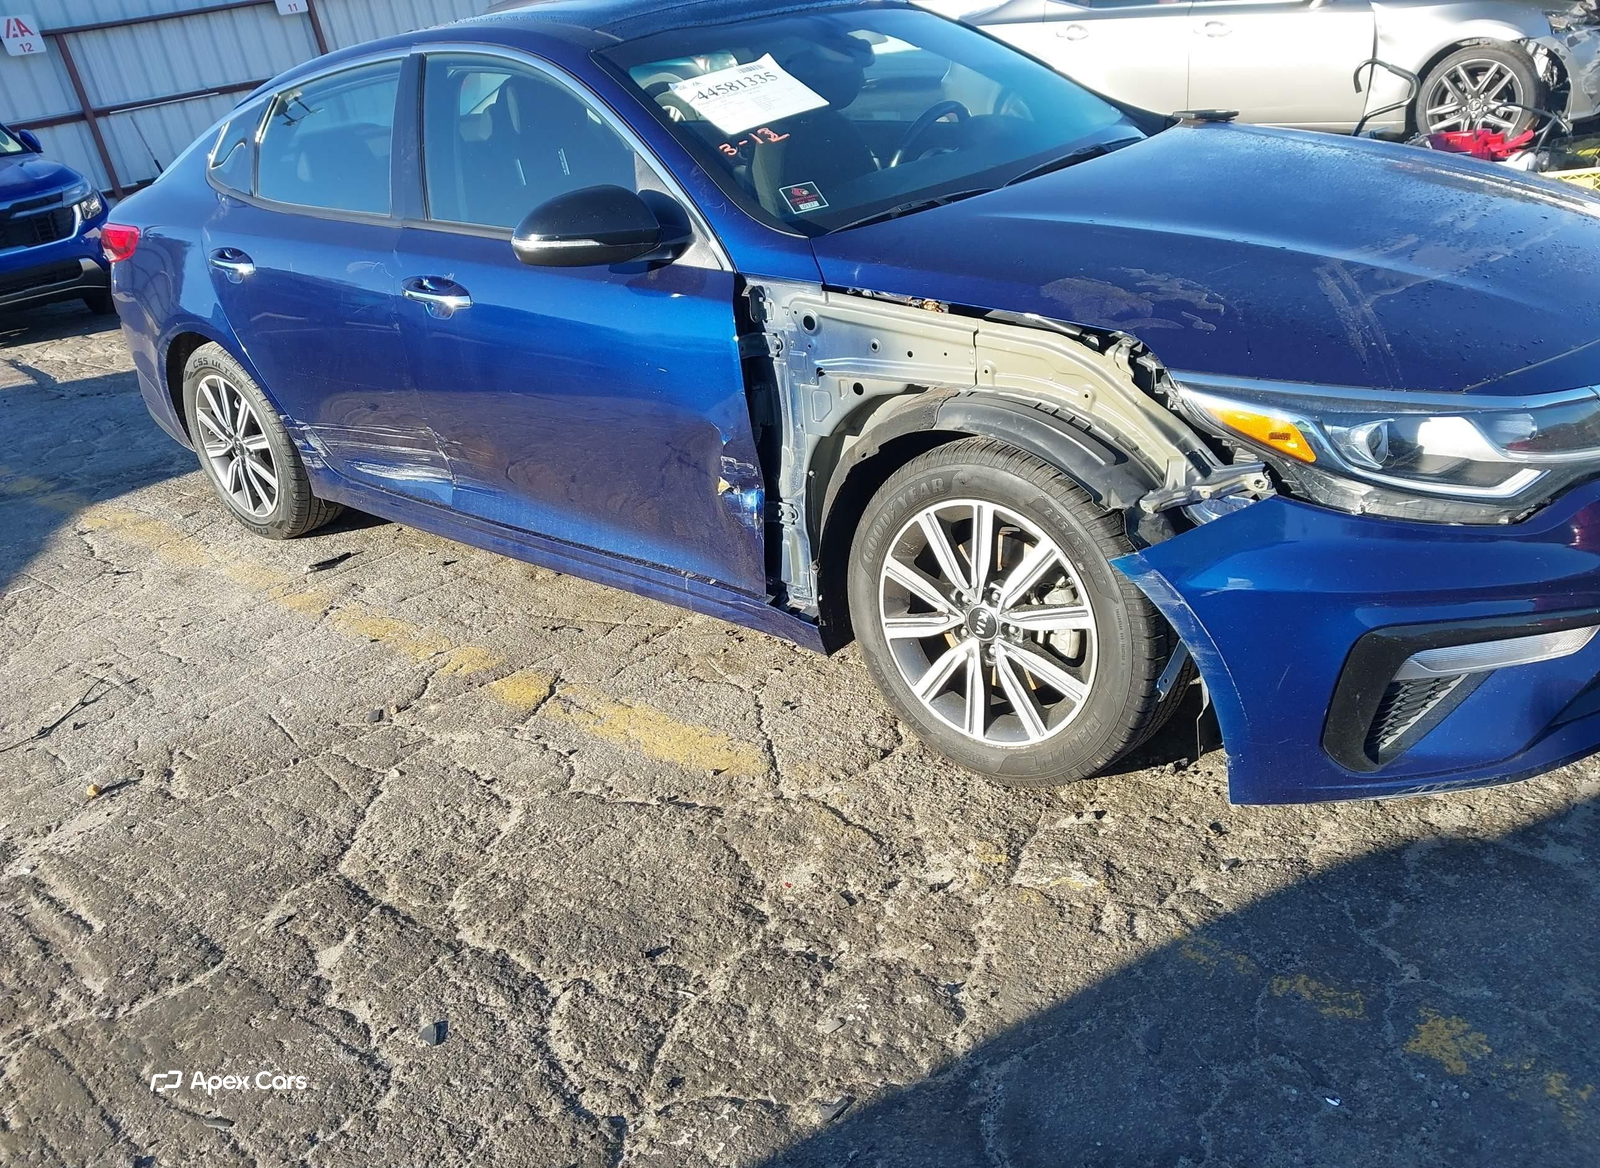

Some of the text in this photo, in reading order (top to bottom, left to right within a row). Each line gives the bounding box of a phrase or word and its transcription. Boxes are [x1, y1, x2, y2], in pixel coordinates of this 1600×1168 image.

[287, 3, 299, 12] 11
[19, 42, 35, 53] 12
[697, 72, 778, 100] 44581335
[863, 478, 945, 564] GOODYEAR
[975, 610, 988, 635] KIA
